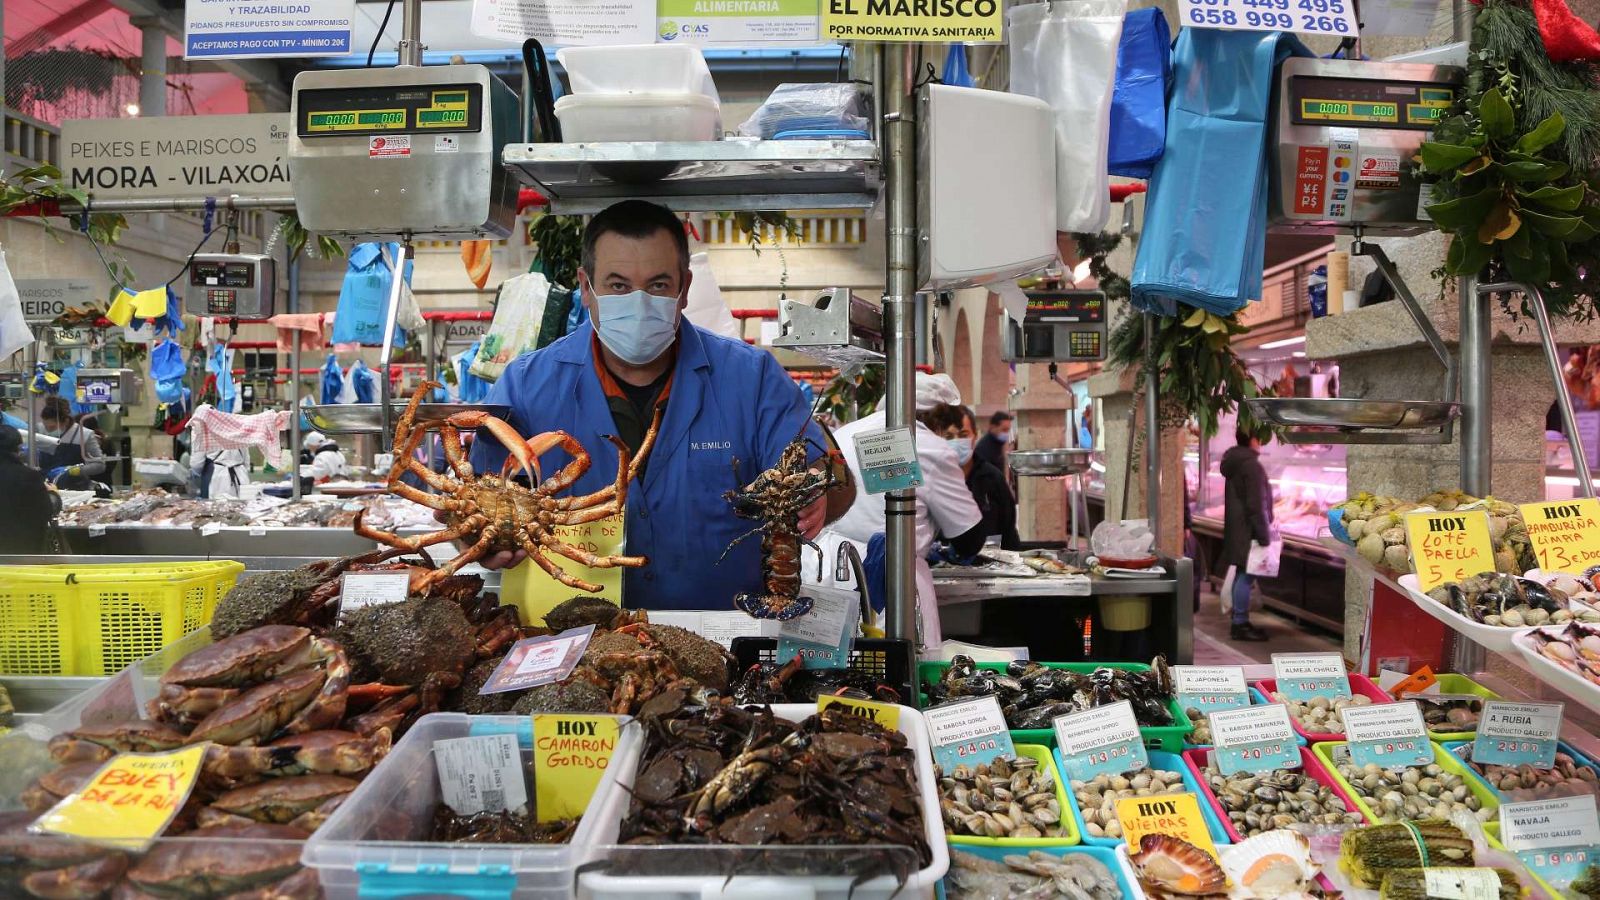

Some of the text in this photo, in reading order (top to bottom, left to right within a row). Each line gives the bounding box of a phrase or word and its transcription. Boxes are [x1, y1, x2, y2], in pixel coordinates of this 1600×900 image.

[229, 5, 311, 15] Y TRAZABILIDAD
[694, 0, 779, 12] ALIMENTARIA
[829, 0, 996, 17] EL MARISCO
[225, 20, 280, 28] PRESUPUESTO
[1190, 8, 1349, 33] 658 999 266
[829, 25, 995, 36] POR NORMATIVA SANITARIA
[192, 42, 238, 50] ACEPTAMOS
[240, 40, 262, 48] PAGO
[262, 40, 280, 48] CON
[281, 39, 296, 47] TPV
[331, 38, 345, 46] 20€
[71, 138, 256, 158] PEIXES E MARISCOS
[72, 166, 158, 189] MORA
[1299, 173, 1323, 181] currency
[702, 441, 731, 450] EMILIO
[1542, 505, 1582, 519] HOY
[1428, 517, 1466, 532] HOY
[1423, 532, 1467, 548] LOTE
[1423, 547, 1480, 560] PAELLA
[1429, 565, 1443, 584] 5
[1502, 715, 1532, 725] RUBIA
[557, 720, 598, 736] HOY
[940, 724, 1001, 743] PRODUCTO GALLEGO
[1392, 728, 1421, 736] GALLEGO
[1487, 726, 1553, 737] PRODUCTO GALLEGO
[537, 736, 614, 752] CAMARON
[1071, 730, 1135, 751] PRODUCTO GALLEGO
[1224, 735, 1259, 744] PRODUCTO
[546, 752, 609, 769] GORDO
[99, 769, 185, 791] BUEY
[81, 788, 115, 802] DE
[113, 792, 143, 806] LA
[1137, 801, 1177, 817] HOY
[1514, 816, 1550, 826] NAVAJA
[1550, 829, 1581, 837] GALLEGO
